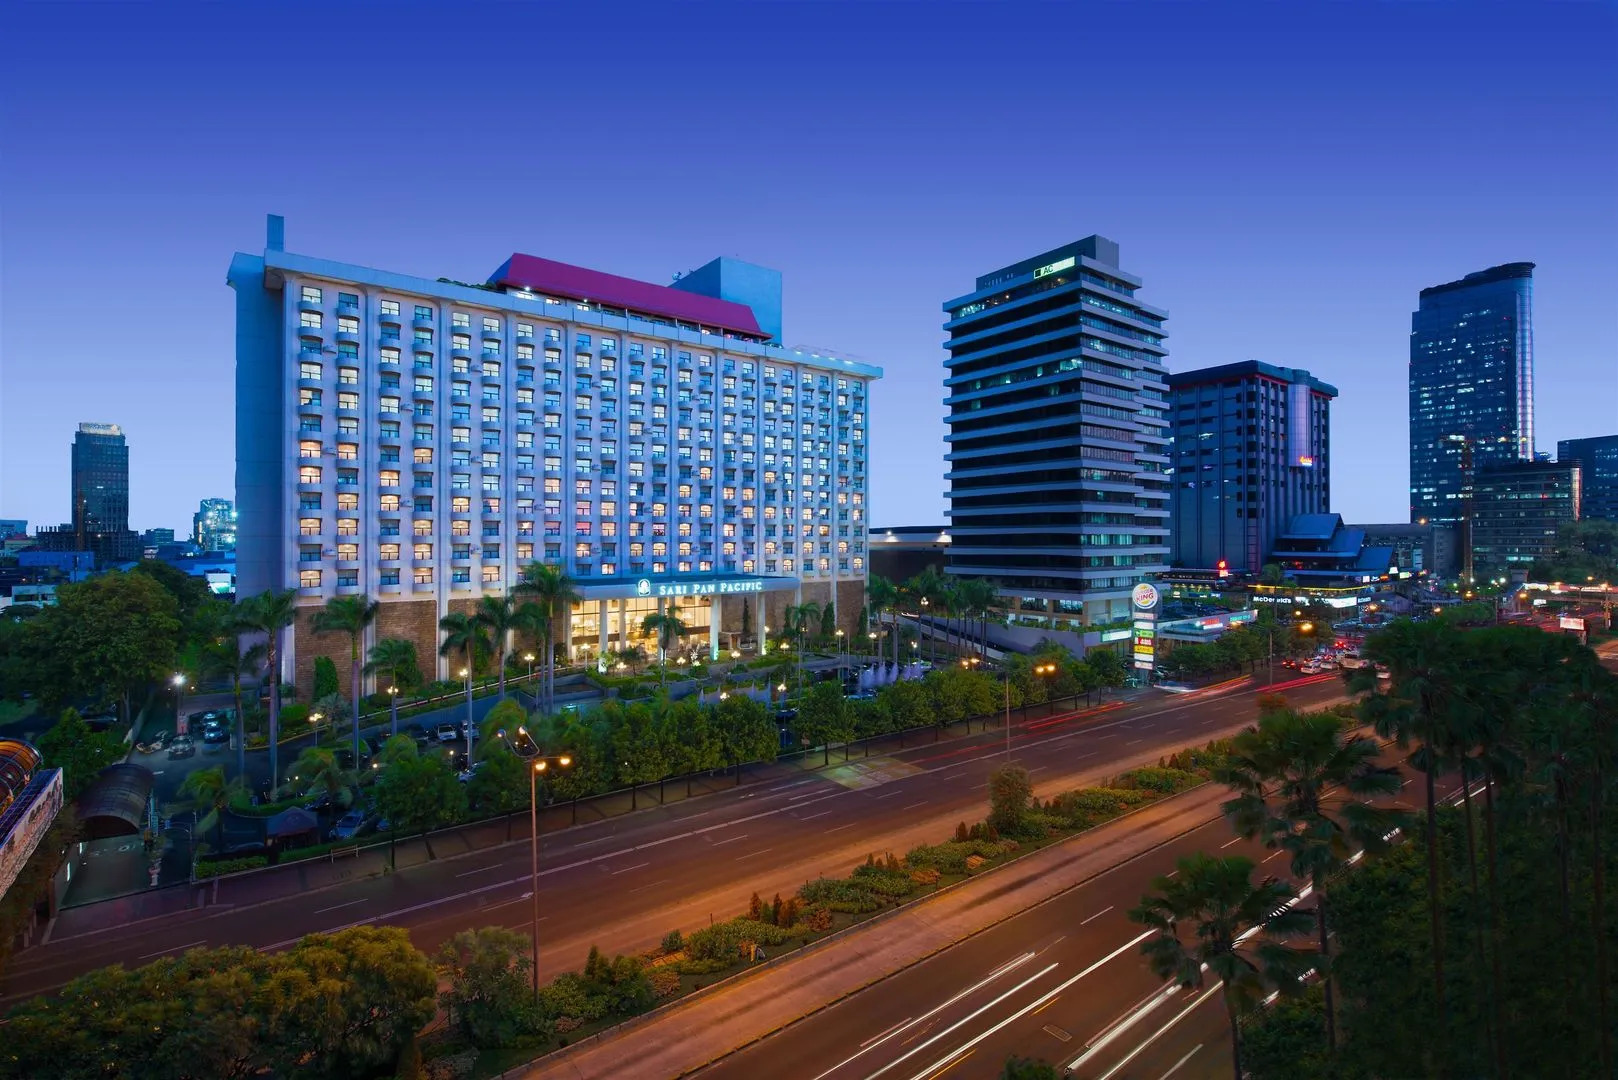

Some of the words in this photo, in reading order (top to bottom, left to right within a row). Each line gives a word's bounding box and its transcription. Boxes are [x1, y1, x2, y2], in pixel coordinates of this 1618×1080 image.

[659, 585, 687, 595] SARI
[693, 583, 715, 594] PAN
[720, 582, 762, 592] PACIFIC
